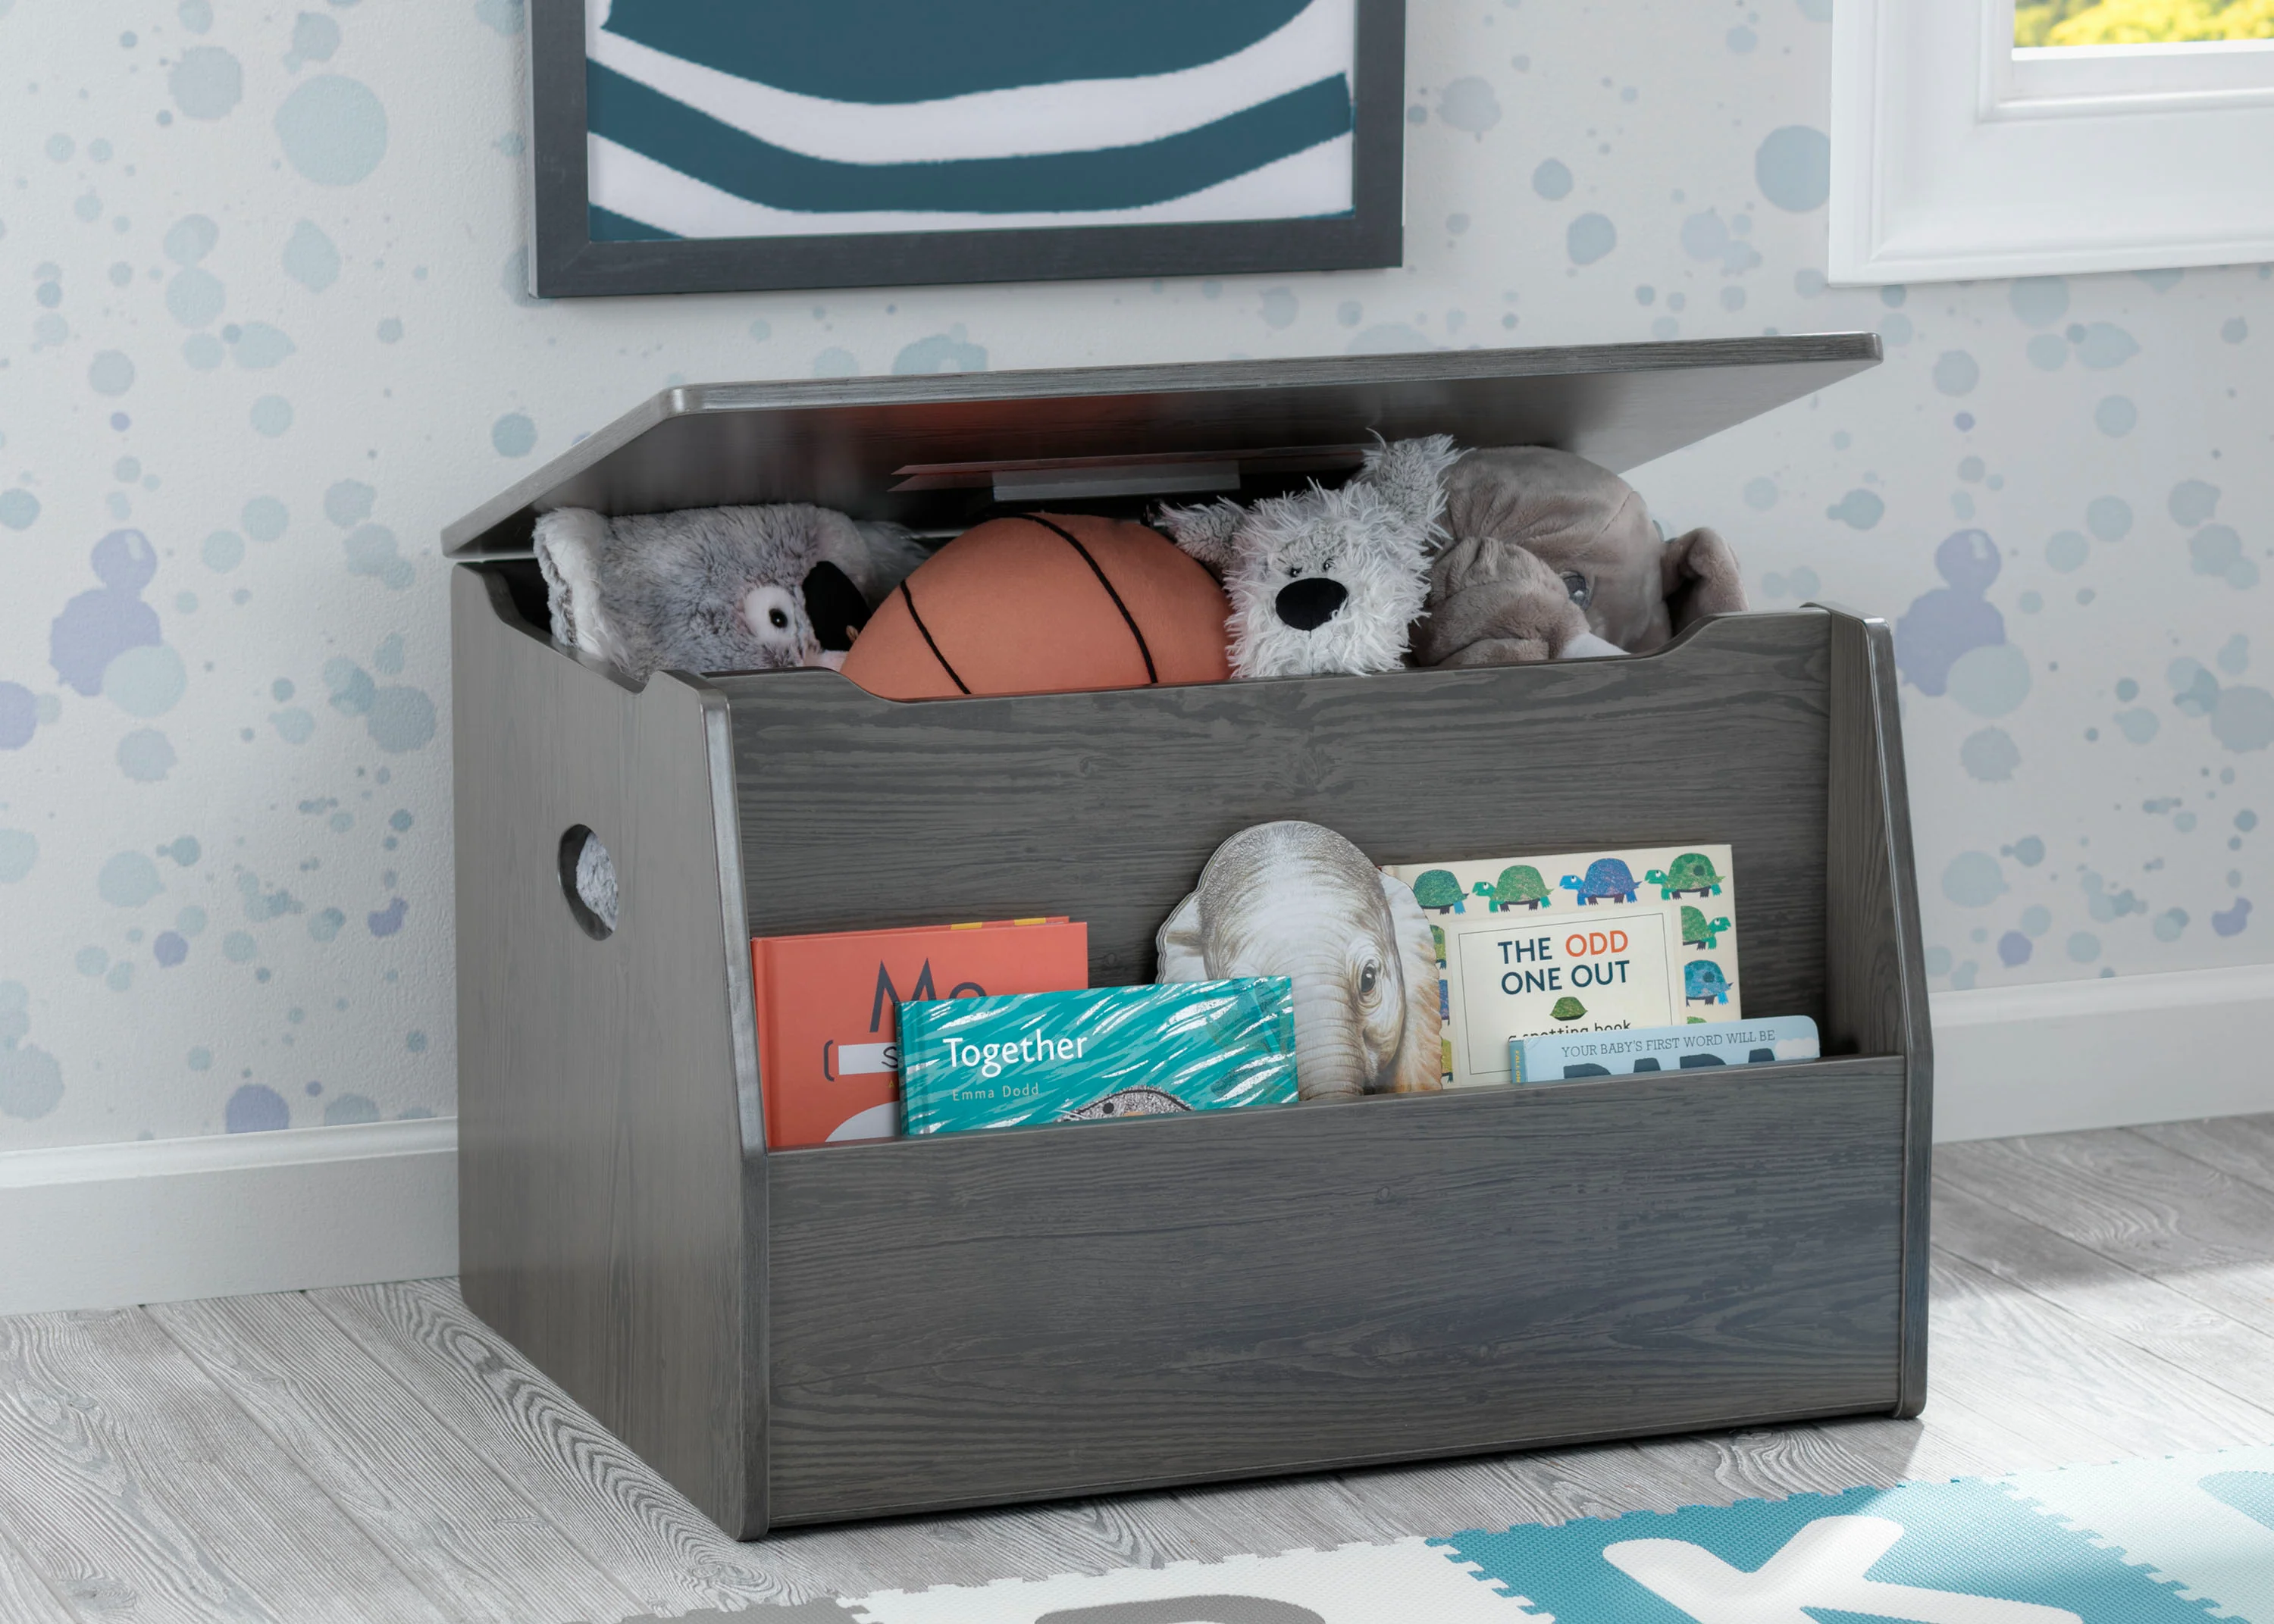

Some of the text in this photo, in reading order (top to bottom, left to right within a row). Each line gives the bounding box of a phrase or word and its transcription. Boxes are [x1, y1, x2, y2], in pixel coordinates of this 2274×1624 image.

[1497, 930, 1628, 965] THE ODD
[1501, 960, 1630, 995] ONE OUT
[942, 1028, 1088, 1078] Together
[1561, 1029, 1776, 1058] YOUR BABY'S FIRST WORD WILL BE
[952, 1082, 1039, 1101] Emma Dodd
